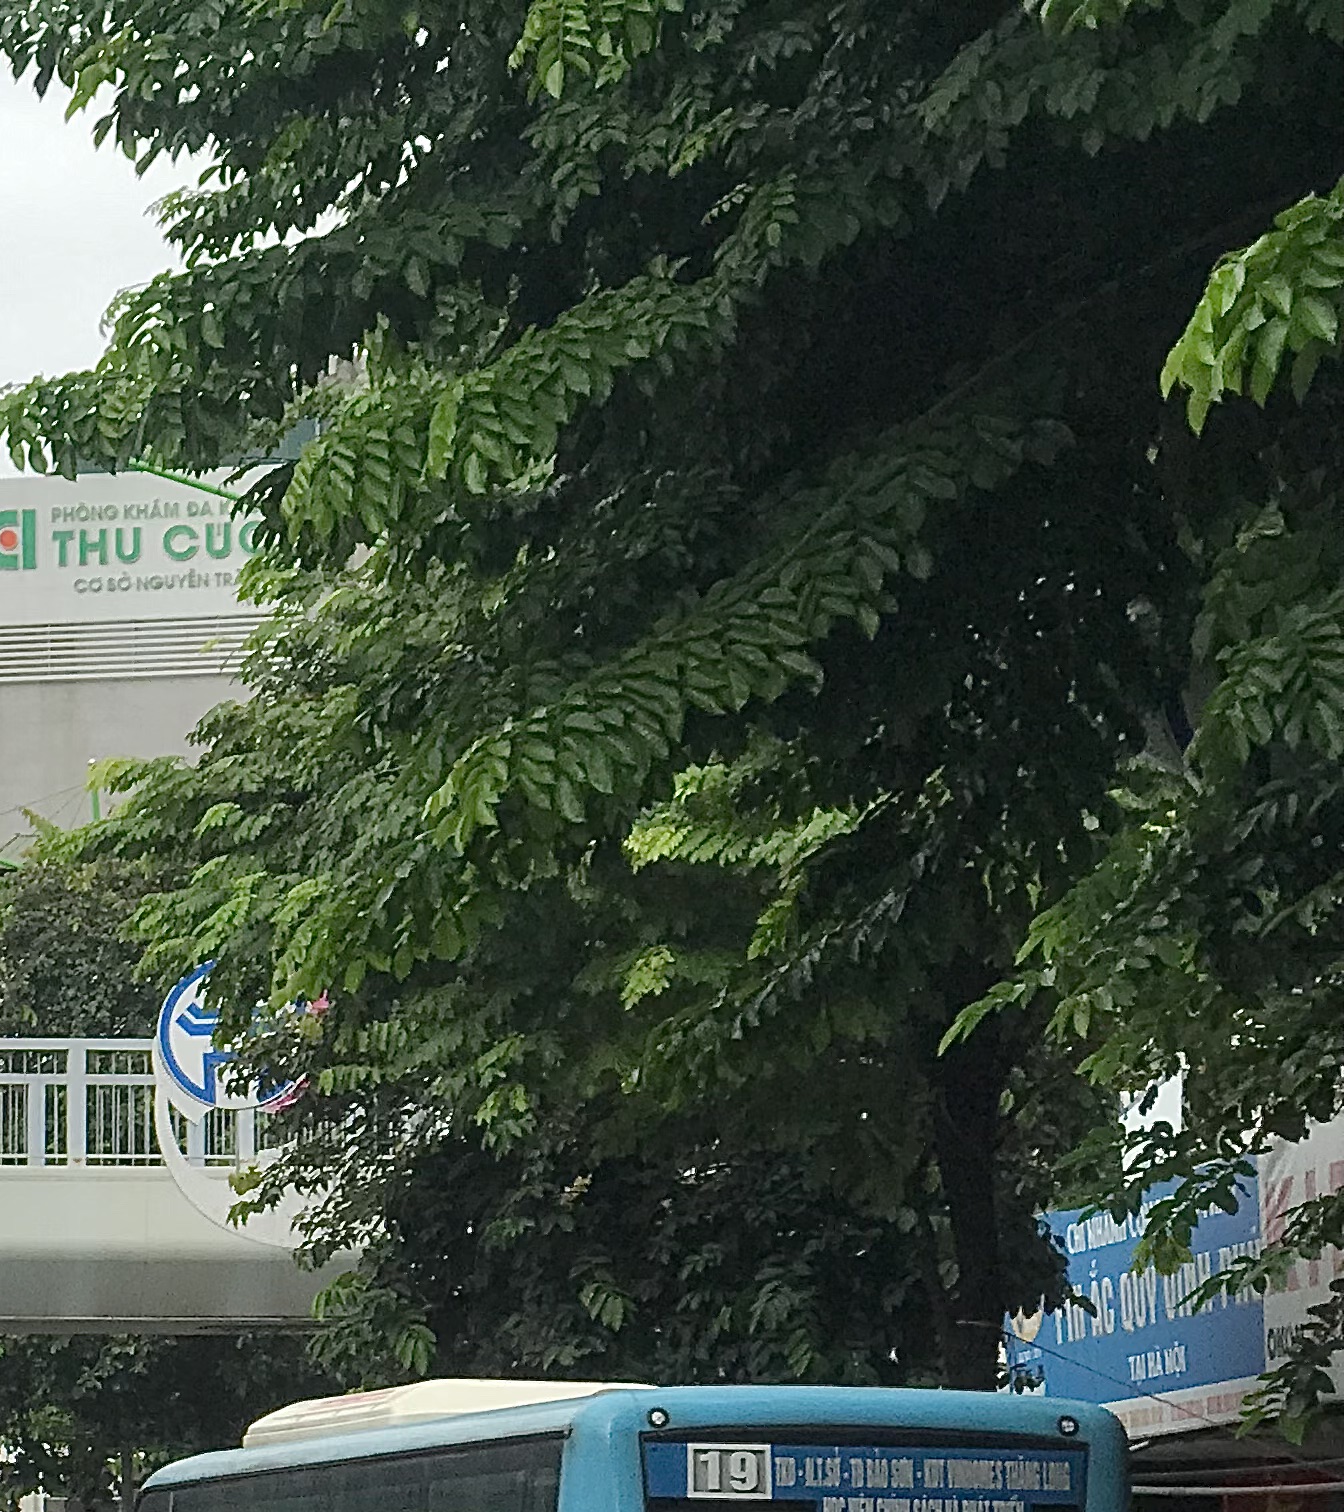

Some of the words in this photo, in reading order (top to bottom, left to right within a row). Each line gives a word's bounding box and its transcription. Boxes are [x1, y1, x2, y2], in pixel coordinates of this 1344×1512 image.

[51, 502, 118, 523] PHÒNG
[123, 499, 181, 520] KHÁM
[187, 500, 212, 517] ĐA
[52, 527, 142, 567] THU
[106, 572, 134, 592] SỞ
[136, 567, 211, 591] NGUYỄN
[698, 1450, 760, 1491] 19
